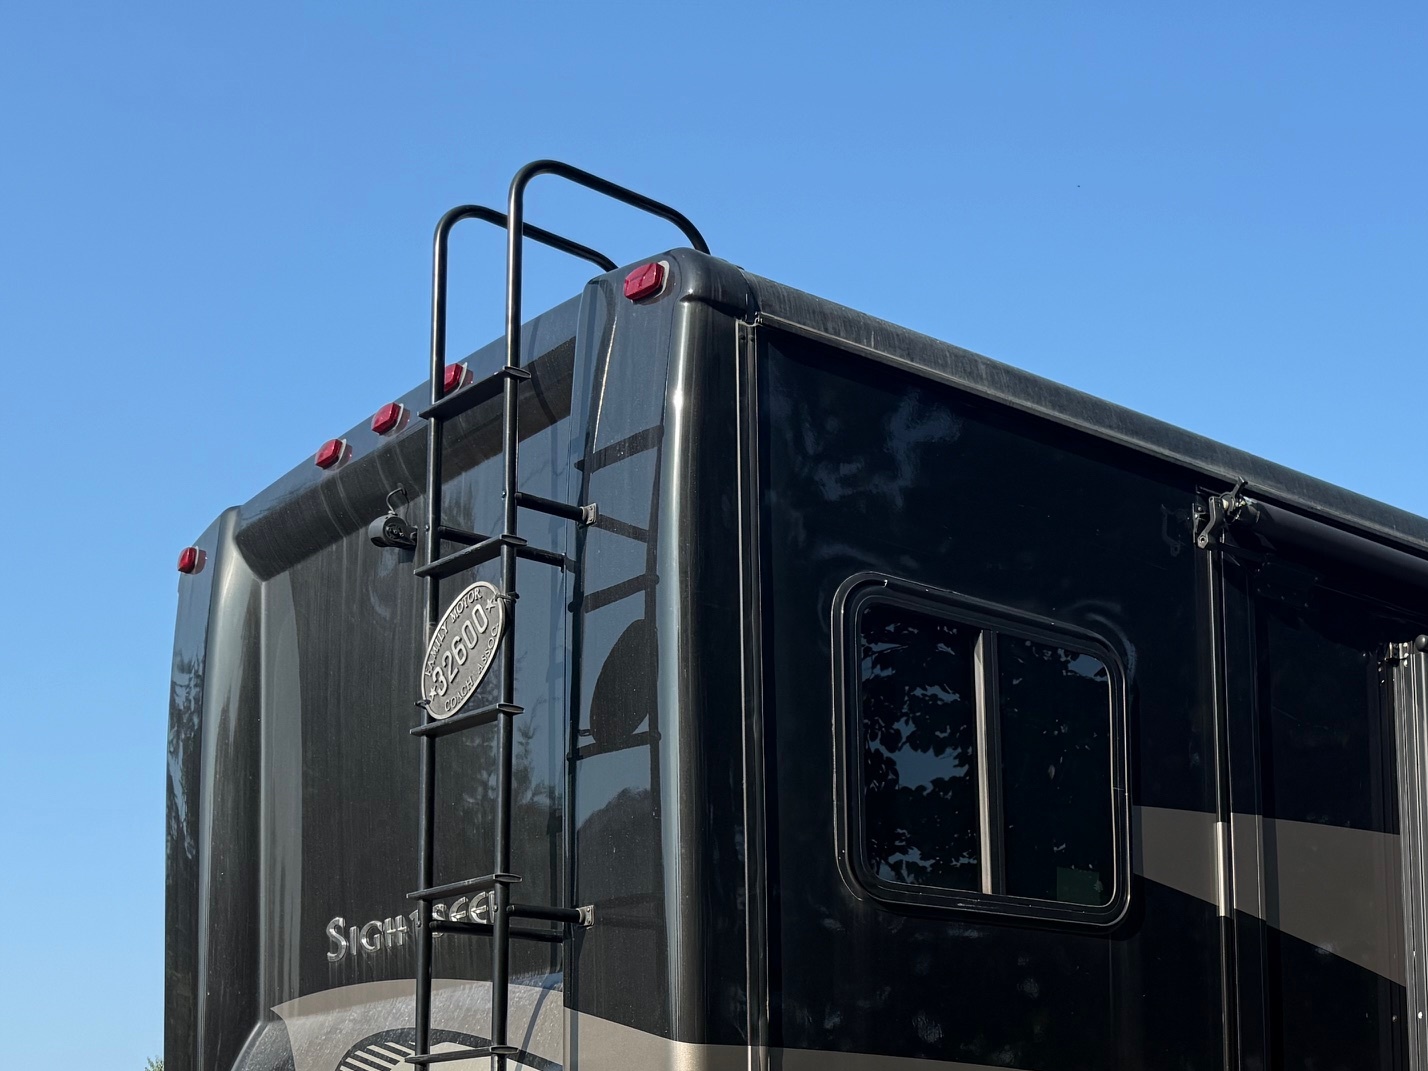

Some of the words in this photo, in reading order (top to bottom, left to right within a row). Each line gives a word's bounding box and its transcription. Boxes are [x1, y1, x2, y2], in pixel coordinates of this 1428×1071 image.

[425, 620, 449, 677] FAMILY
[449, 588, 483, 623] MOTOR
[432, 603, 489, 697] 32600
[444, 676, 474, 712] COACH
[325, 890, 495, 962] SIGHSEE
